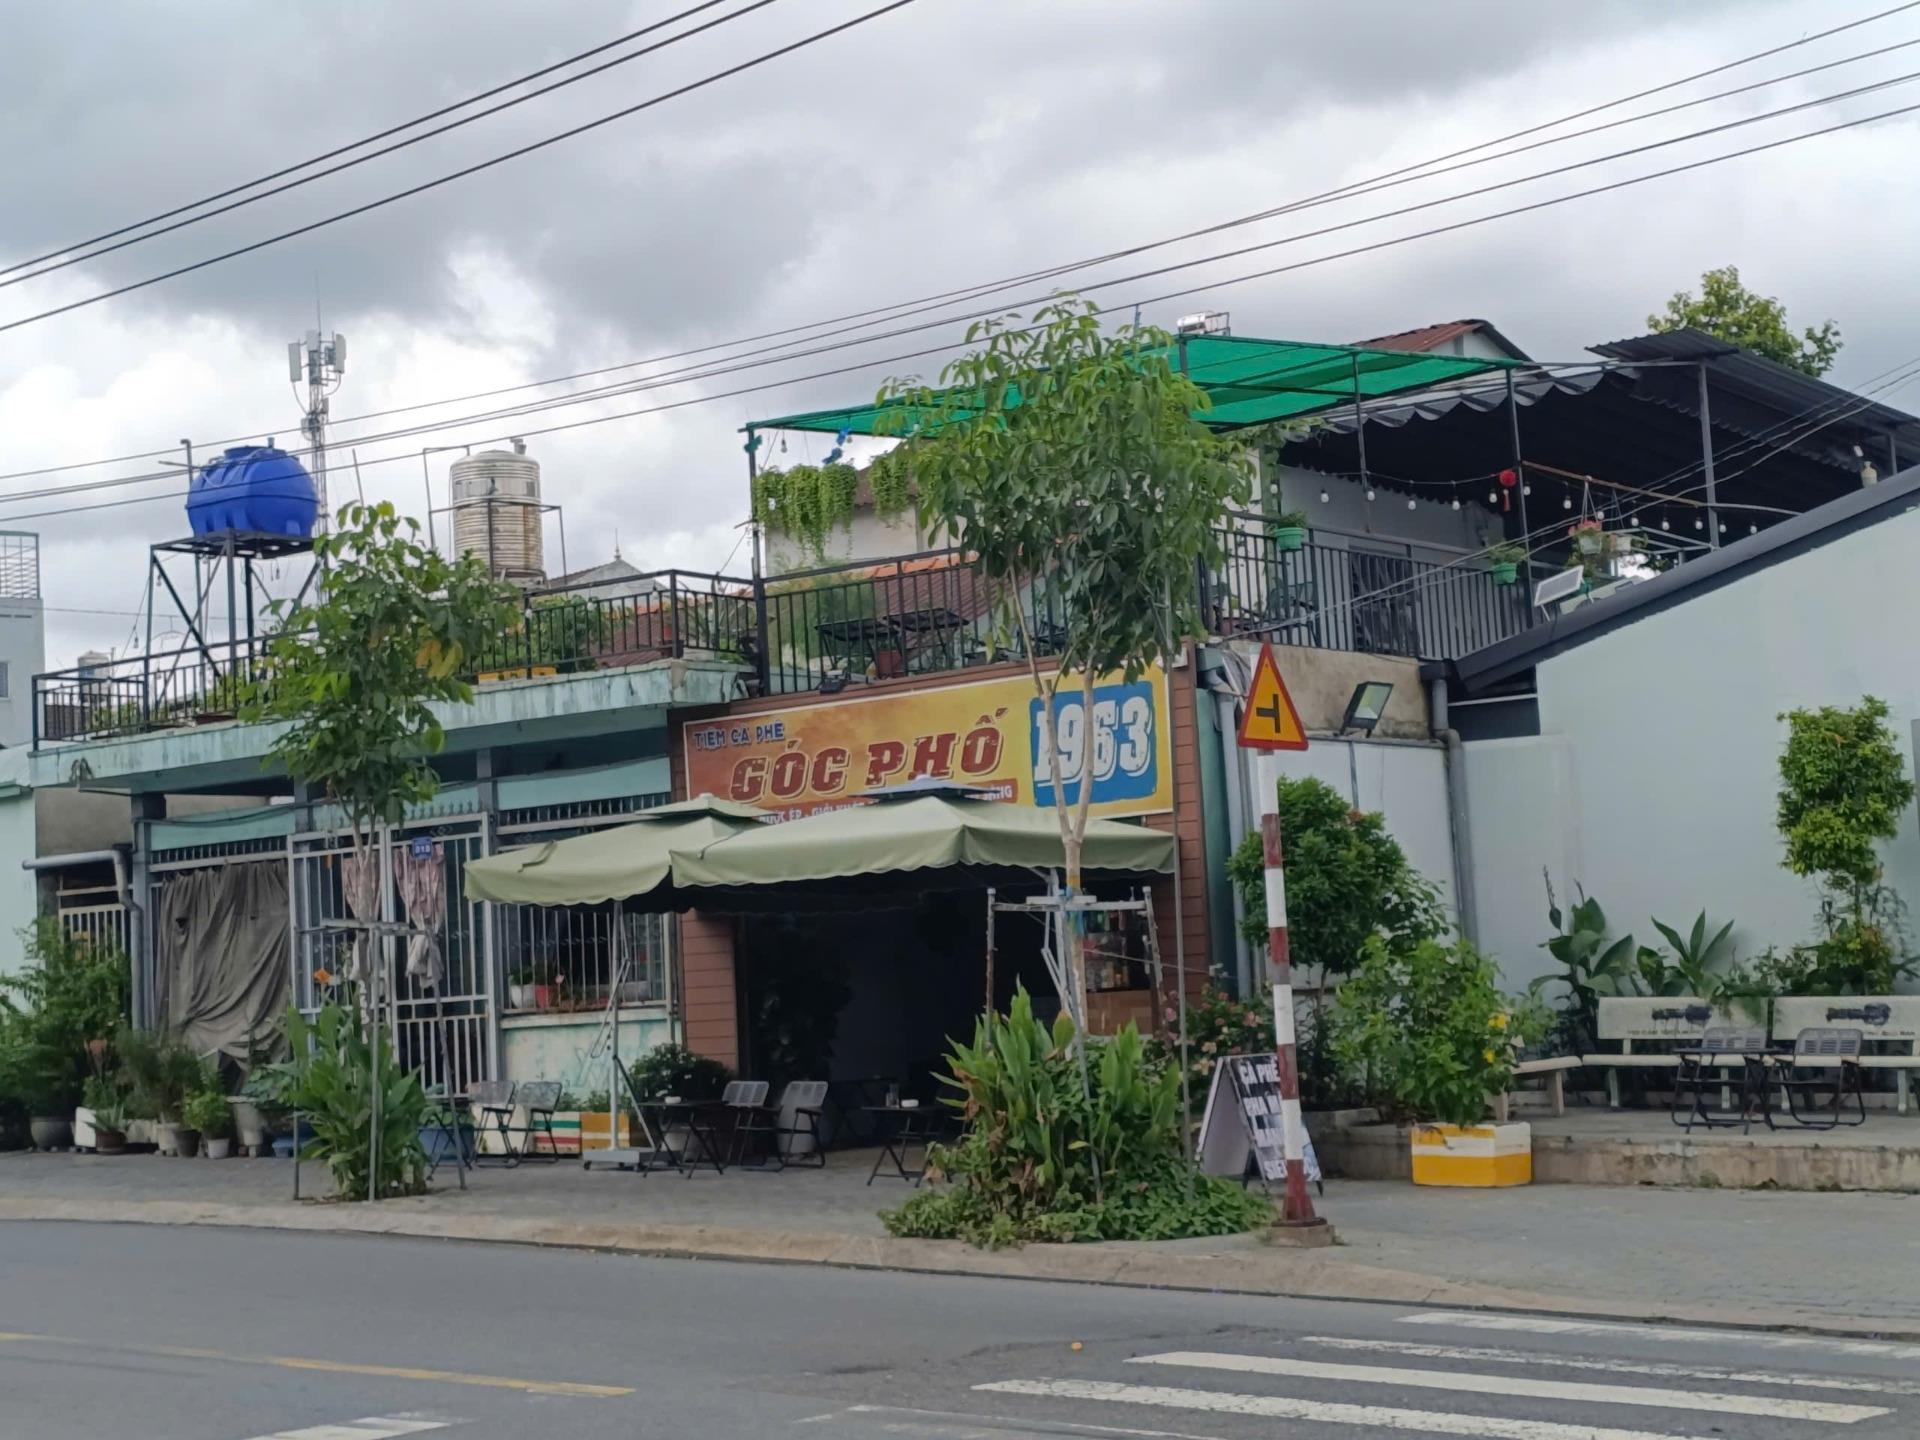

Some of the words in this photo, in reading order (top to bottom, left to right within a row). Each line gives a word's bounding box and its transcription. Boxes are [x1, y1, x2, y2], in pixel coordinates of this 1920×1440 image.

[729, 739, 850, 802] GÓC
[865, 708, 1008, 787] PHỐ
[756, 719, 785, 743] PHÊ
[1036, 697, 1154, 785] 1963
